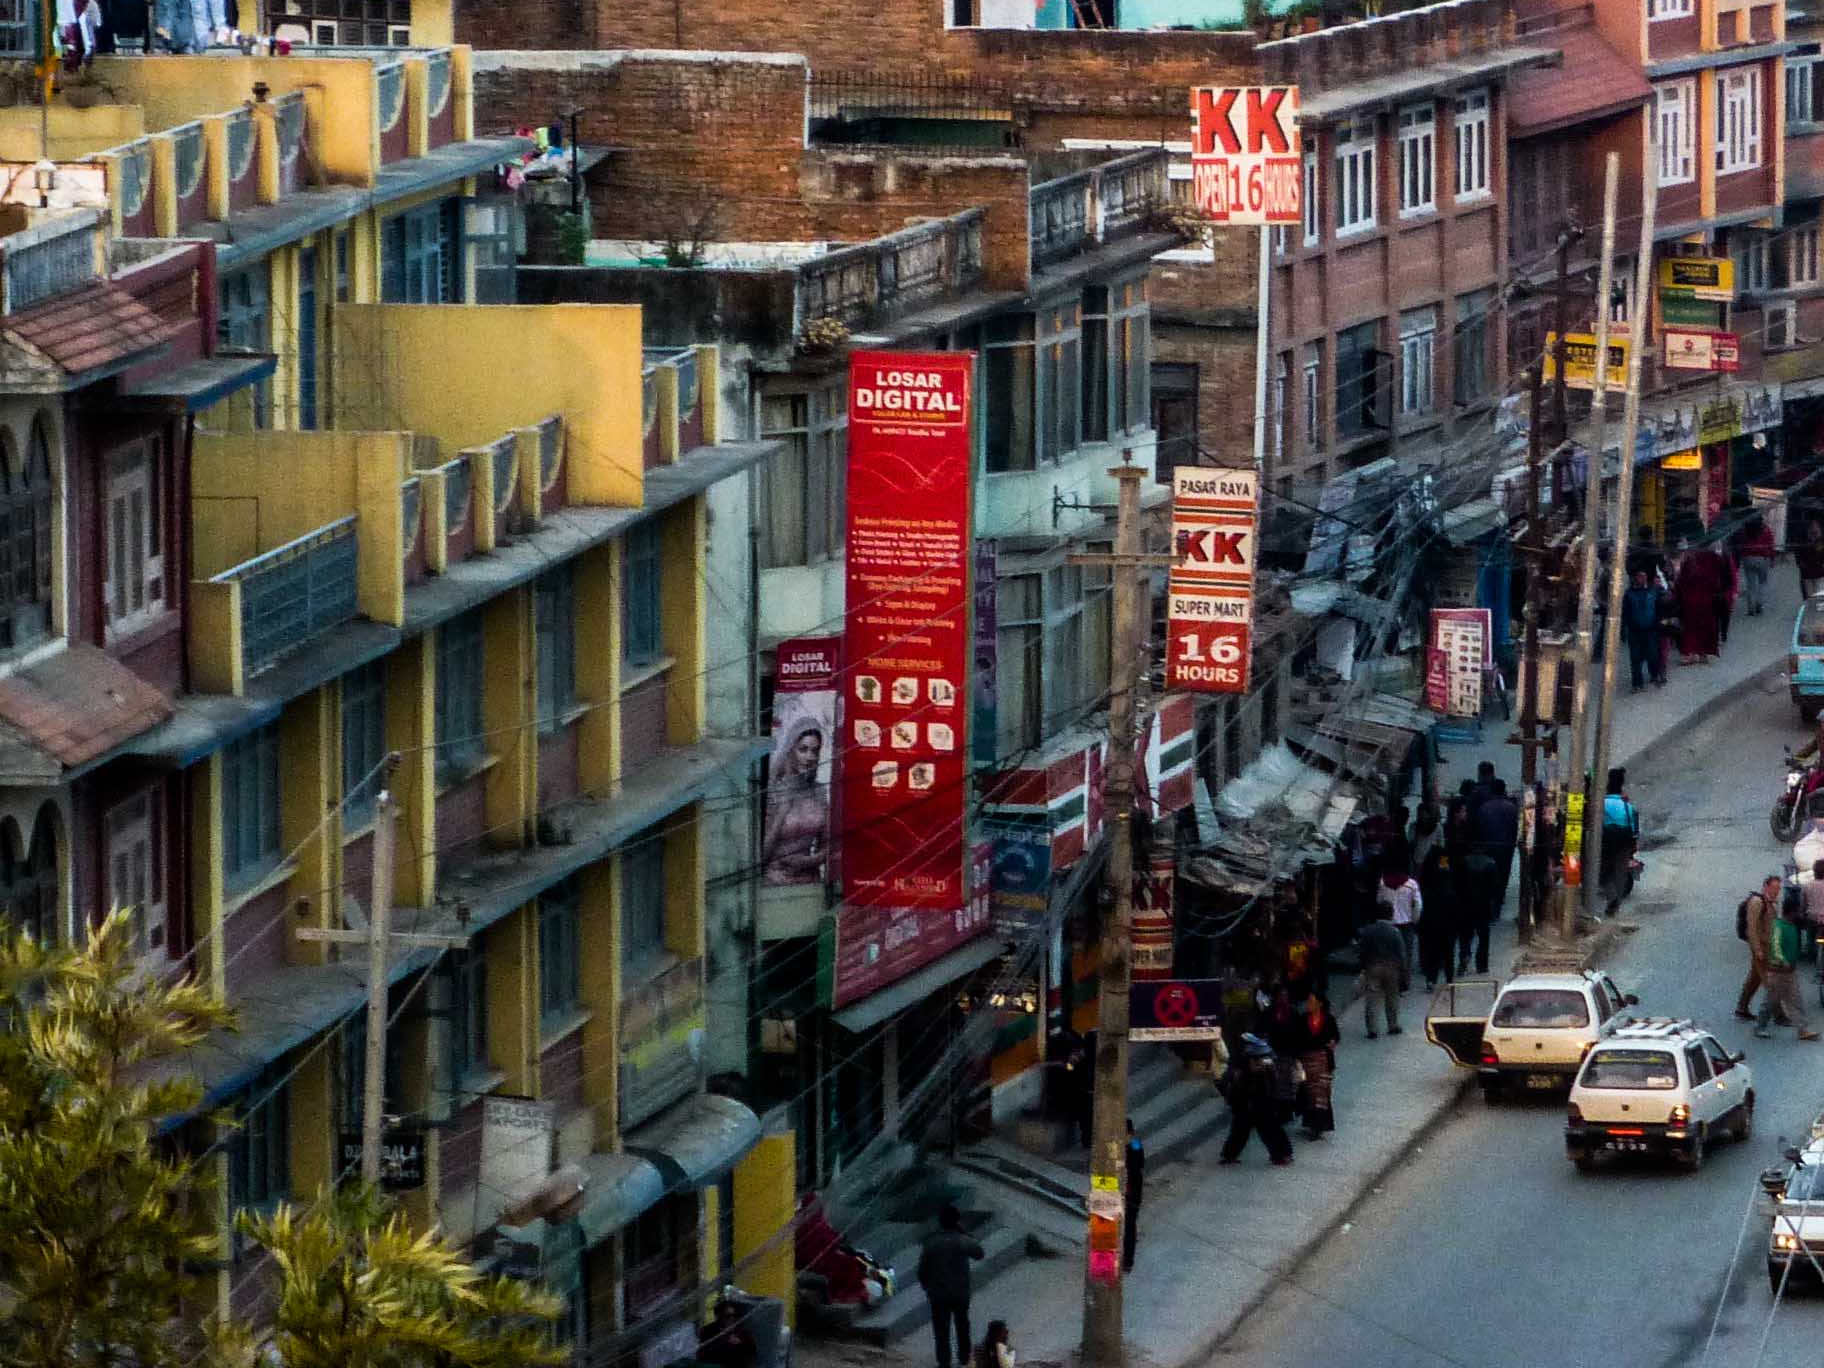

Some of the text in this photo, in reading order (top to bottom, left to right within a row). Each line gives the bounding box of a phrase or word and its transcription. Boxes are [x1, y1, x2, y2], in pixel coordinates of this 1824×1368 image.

[1199, 88, 1290, 154] KK
[1193, 163, 1301, 214] OPEN 16 HOURS
[875, 371, 943, 388] LOSAR
[856, 388, 961, 411] DIGITAL
[1180, 480, 1250, 497] PASAR RAYA
[1176, 530, 1248, 564] KK
[1175, 599, 1245, 618] SUPER MART
[791, 652, 824, 662] LOSAR
[1178, 634, 1241, 665] 16
[781, 662, 832, 674] DIGITAL
[1175, 665, 1239, 683] HOURS
